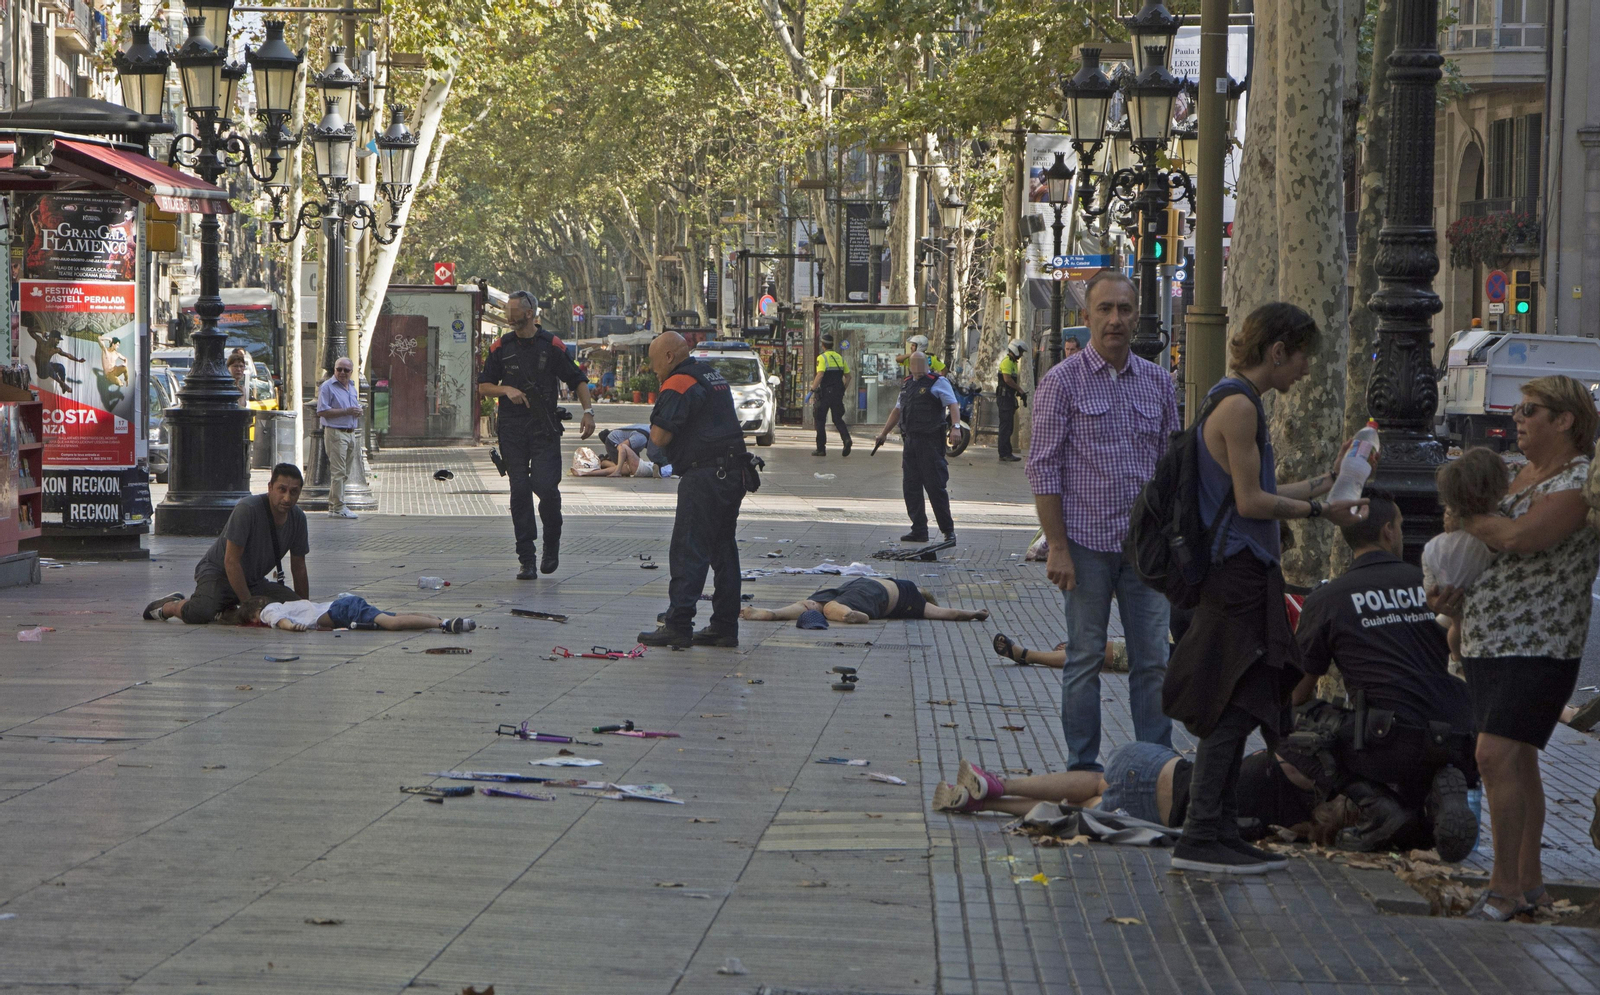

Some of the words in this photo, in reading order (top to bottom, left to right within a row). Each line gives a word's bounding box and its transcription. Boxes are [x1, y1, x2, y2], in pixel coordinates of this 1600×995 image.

[1174, 59, 1199, 67] LÈXIC
[58, 222, 98, 238] GRAN
[98, 225, 127, 240] GALA
[41, 229, 127, 254] FLAMENCO
[45, 287, 84, 295] FESTIVAL
[84, 296, 125, 304] PERALADA
[42, 409, 98, 424] COSTA
[42, 425, 66, 434] NZA
[42, 477, 66, 493] KON
[73, 476, 120, 493] RECKON
[71, 504, 118, 520] RECKON
[1351, 586, 1427, 614] POLICIA
[1361, 613, 1401, 628] Guàrdia
